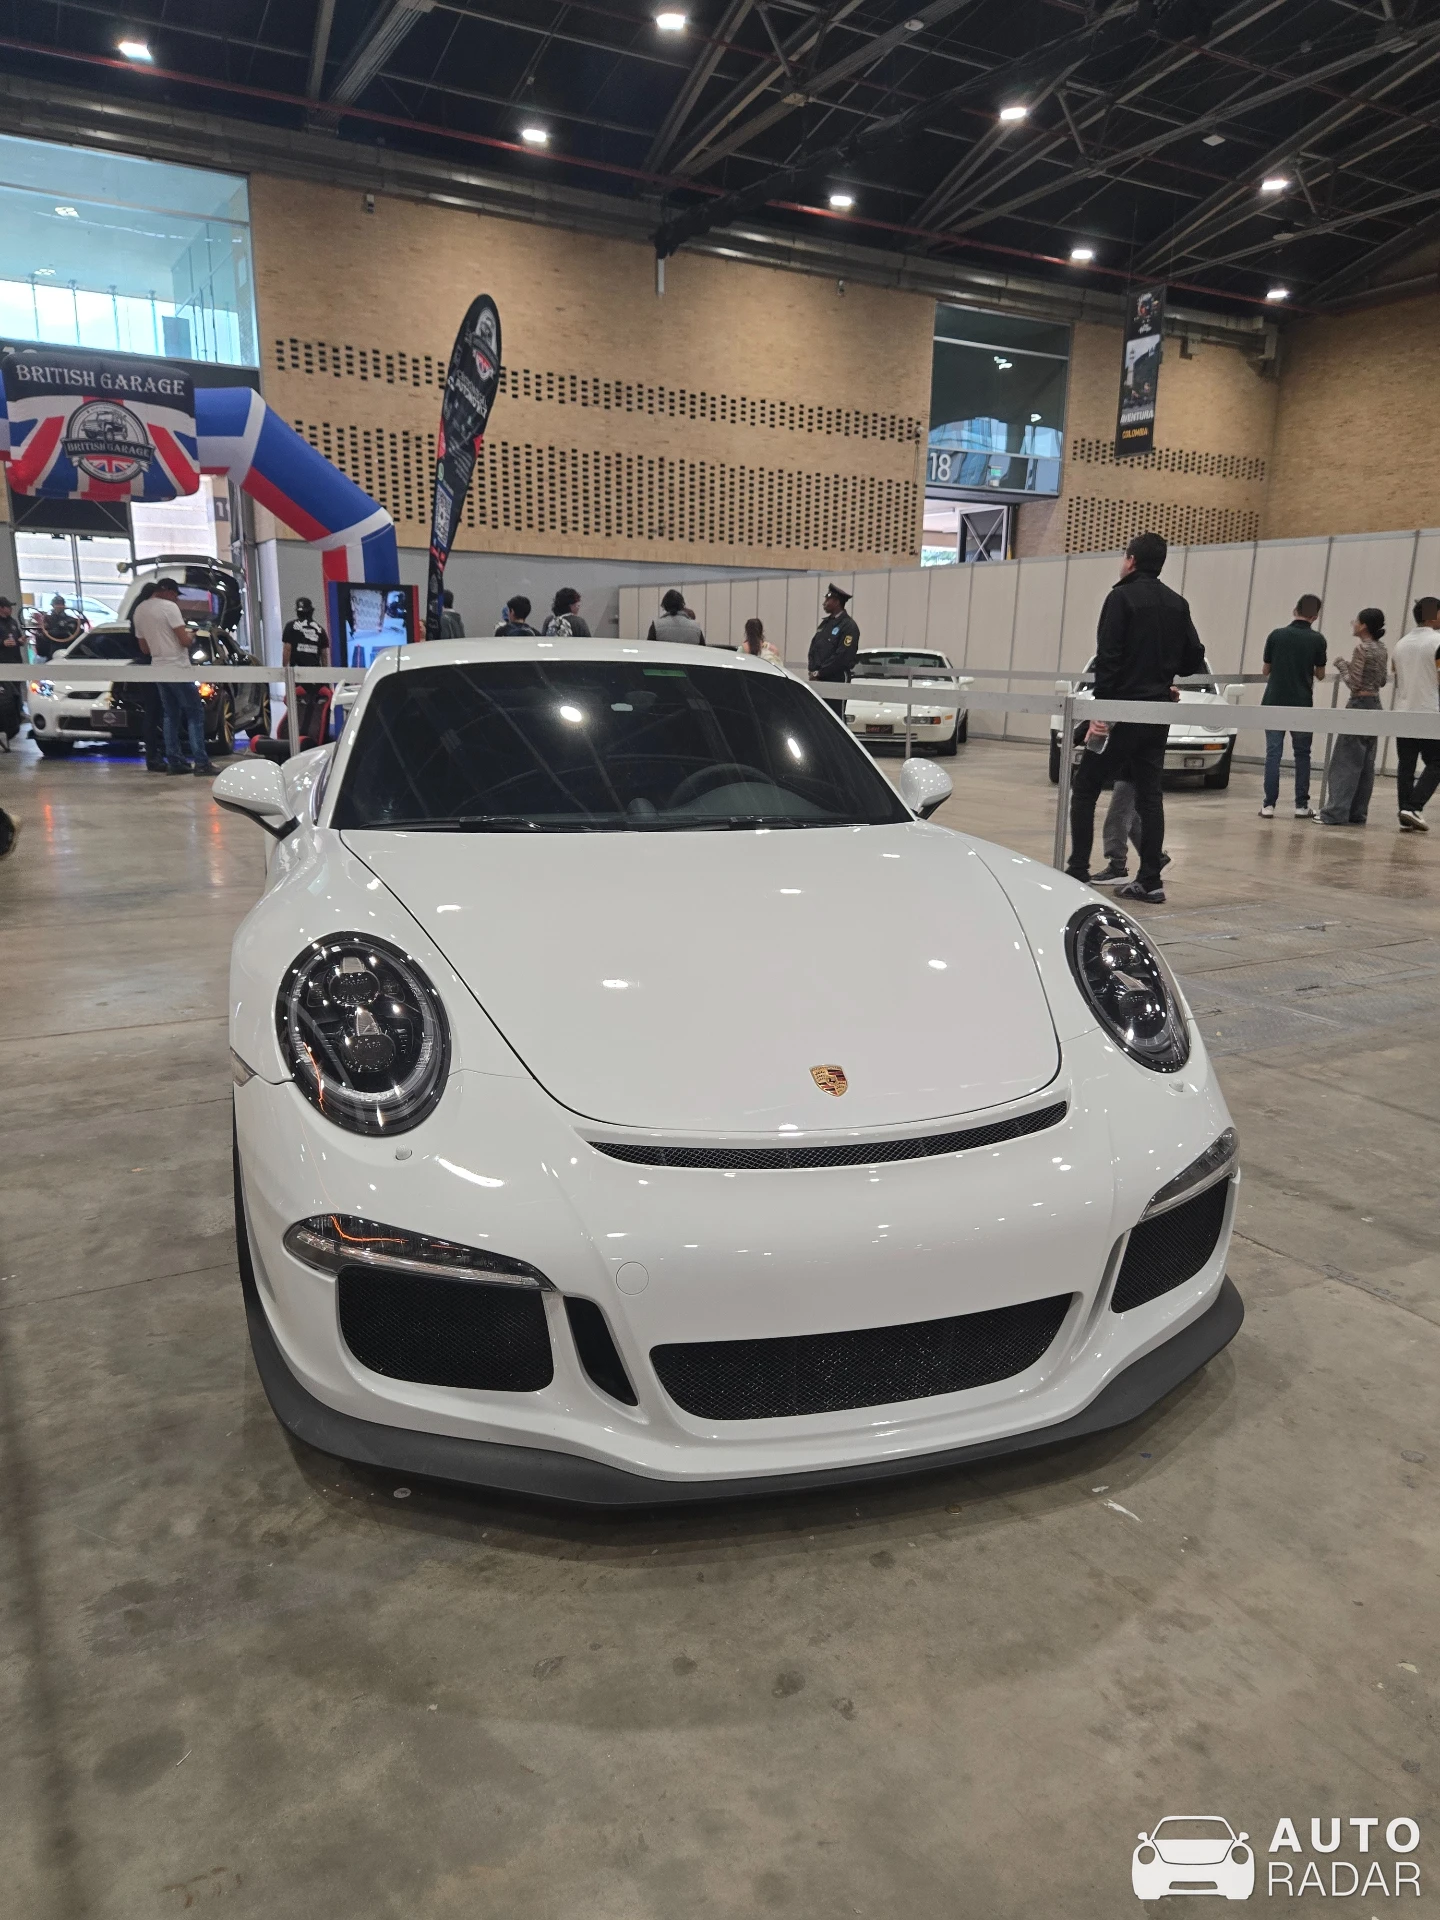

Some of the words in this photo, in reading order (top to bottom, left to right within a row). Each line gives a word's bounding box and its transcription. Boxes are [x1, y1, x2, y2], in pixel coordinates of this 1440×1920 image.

[16, 364, 95, 388] BRITISH
[100, 373, 185, 396] GARAGE
[67, 442, 106, 452] BRITISH
[106, 443, 150, 457] GARAGE
[930, 452, 951, 481] 18
